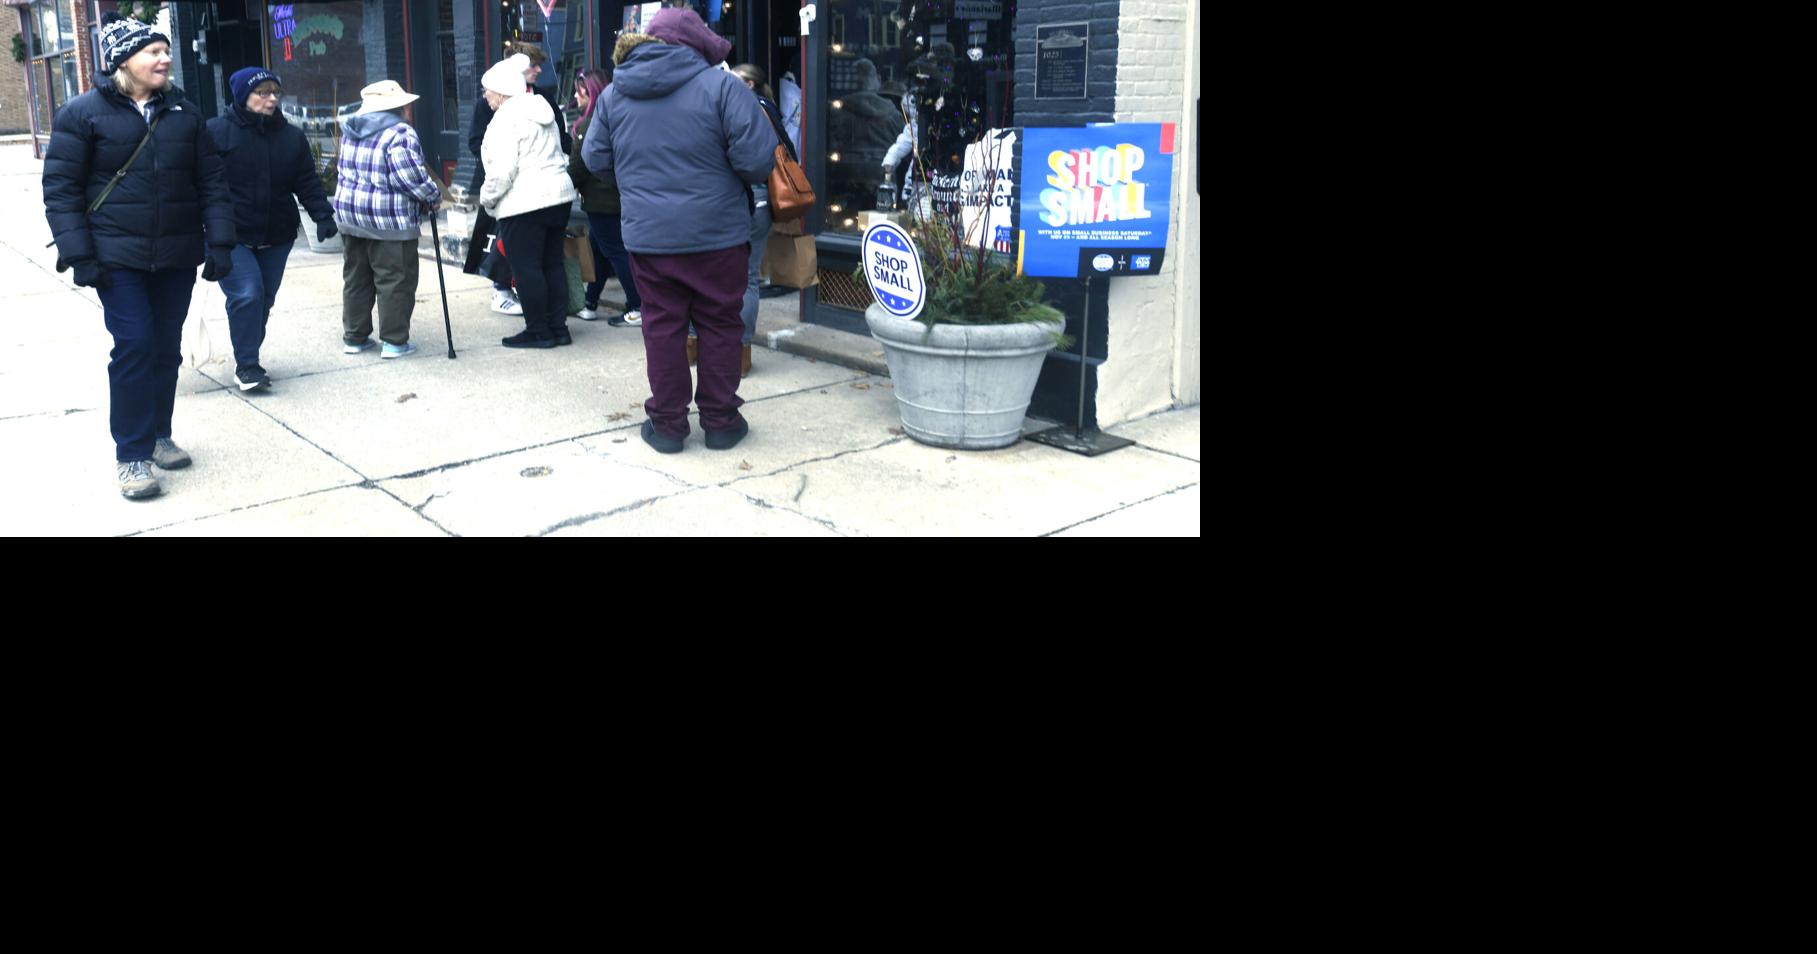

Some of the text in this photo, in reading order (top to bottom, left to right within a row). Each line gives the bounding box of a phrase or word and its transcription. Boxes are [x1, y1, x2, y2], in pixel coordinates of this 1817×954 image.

[1046, 143, 1145, 190] SHOP
[1039, 182, 1152, 228] SMALL
[874, 250, 908, 273] SHOP
[874, 265, 914, 292] SMALL
